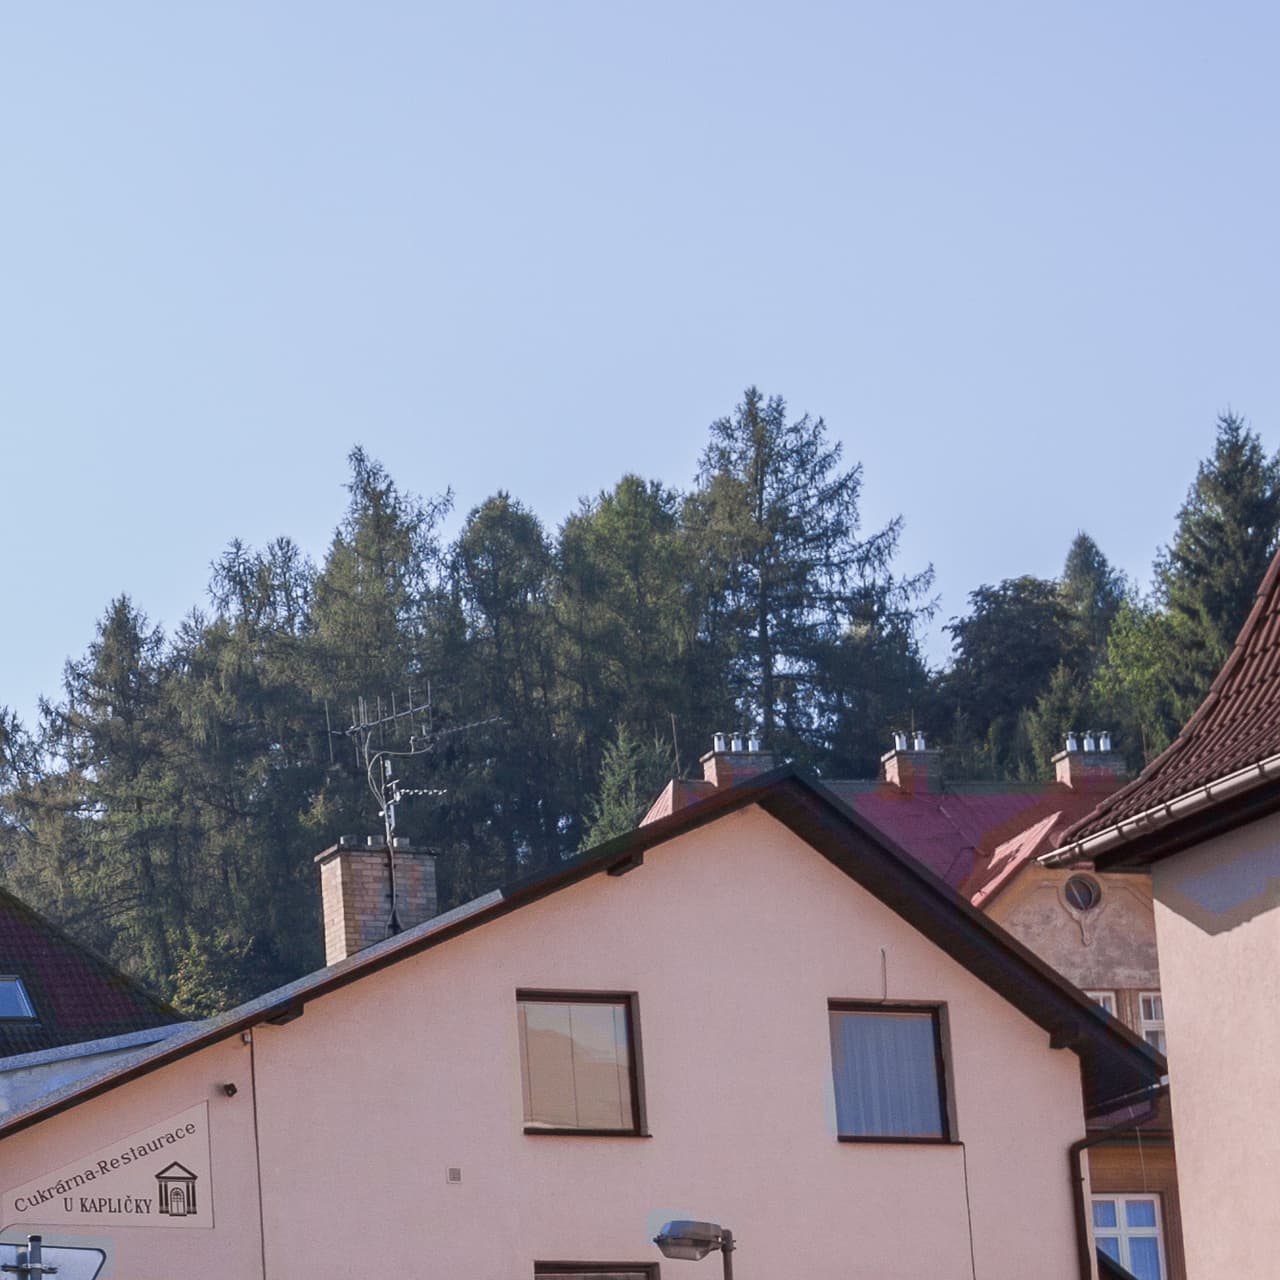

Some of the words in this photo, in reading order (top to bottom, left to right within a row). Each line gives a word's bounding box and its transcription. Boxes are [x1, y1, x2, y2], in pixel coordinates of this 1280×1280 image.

[14, 1122, 197, 1213] Cukrárna-Restaurace
[63, 1197, 74, 1213] U
[80, 1195, 153, 1214] KAPLIČKY
